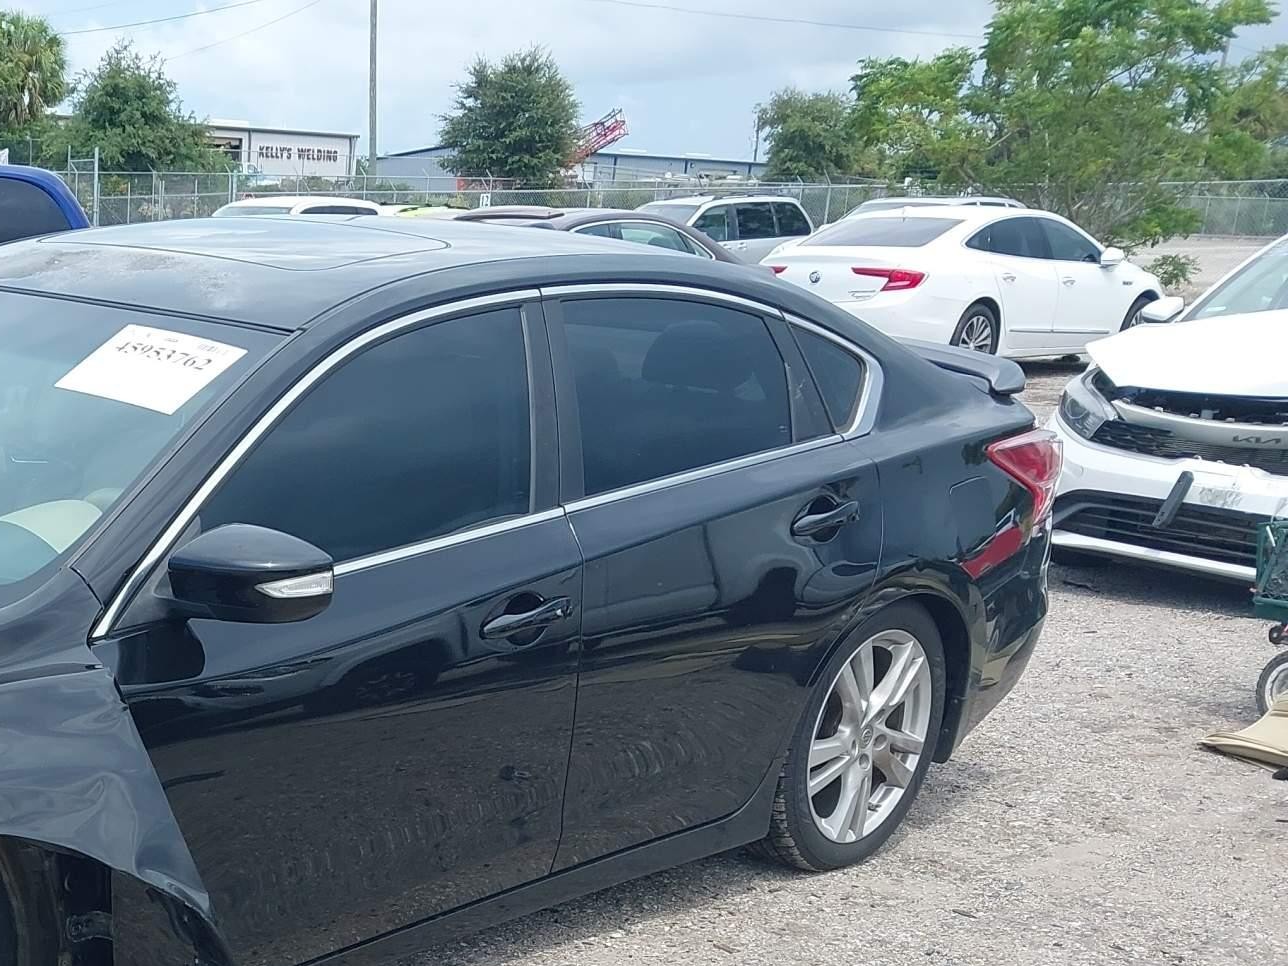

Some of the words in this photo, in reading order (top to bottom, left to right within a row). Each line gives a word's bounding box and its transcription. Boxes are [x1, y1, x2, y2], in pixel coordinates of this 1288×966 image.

[258, 144, 293, 160] KELLY'S
[297, 147, 338, 162] WELDING
[115, 340, 213, 371] 45953762
